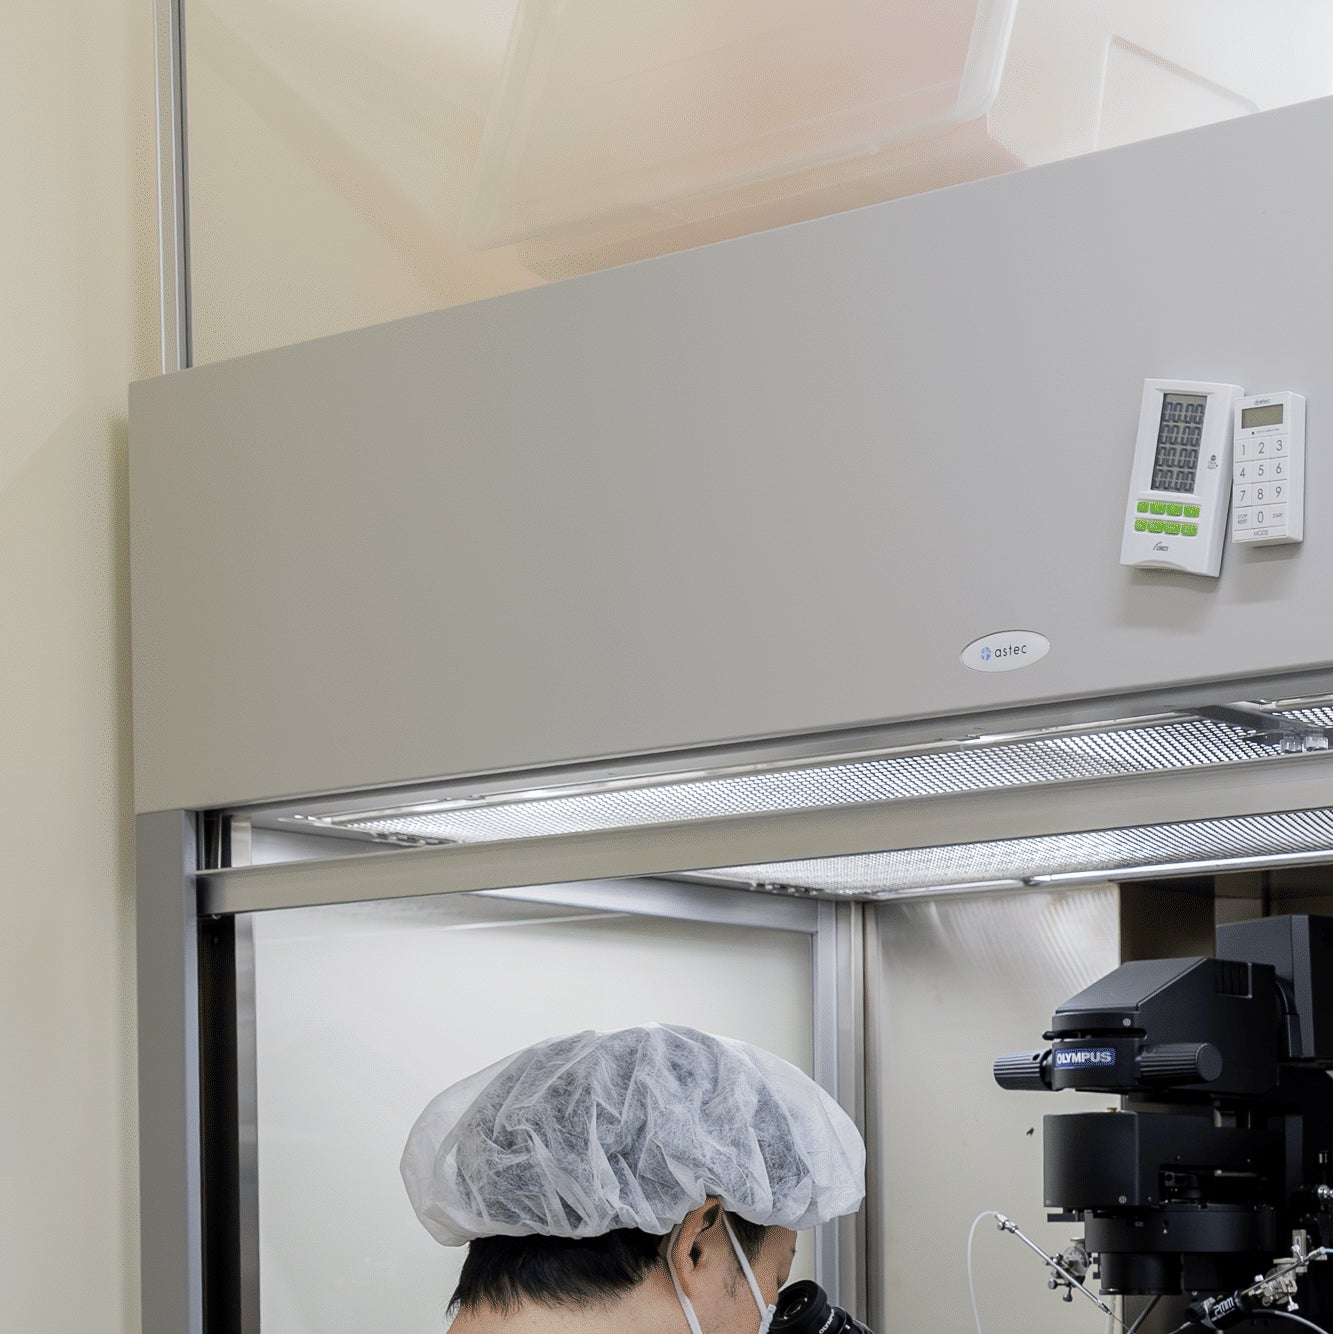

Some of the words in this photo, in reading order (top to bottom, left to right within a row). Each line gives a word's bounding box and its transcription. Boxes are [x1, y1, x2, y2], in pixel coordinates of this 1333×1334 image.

[1242, 444, 1246, 456] 1
[1258, 442, 1265, 454] 2
[1276, 440, 1282, 451] 3
[1240, 467, 1246, 478] 4
[1258, 465, 1264, 476] 5
[1276, 463, 1282, 474] 6
[1240, 490, 1246, 502] 7
[1257, 489, 1264, 500] 8
[1275, 487, 1282, 498] 9
[1257, 511, 1264, 523] 0
[995, 645, 1027, 658] astec
[1057, 1051, 1112, 1064] OLYMPUS
